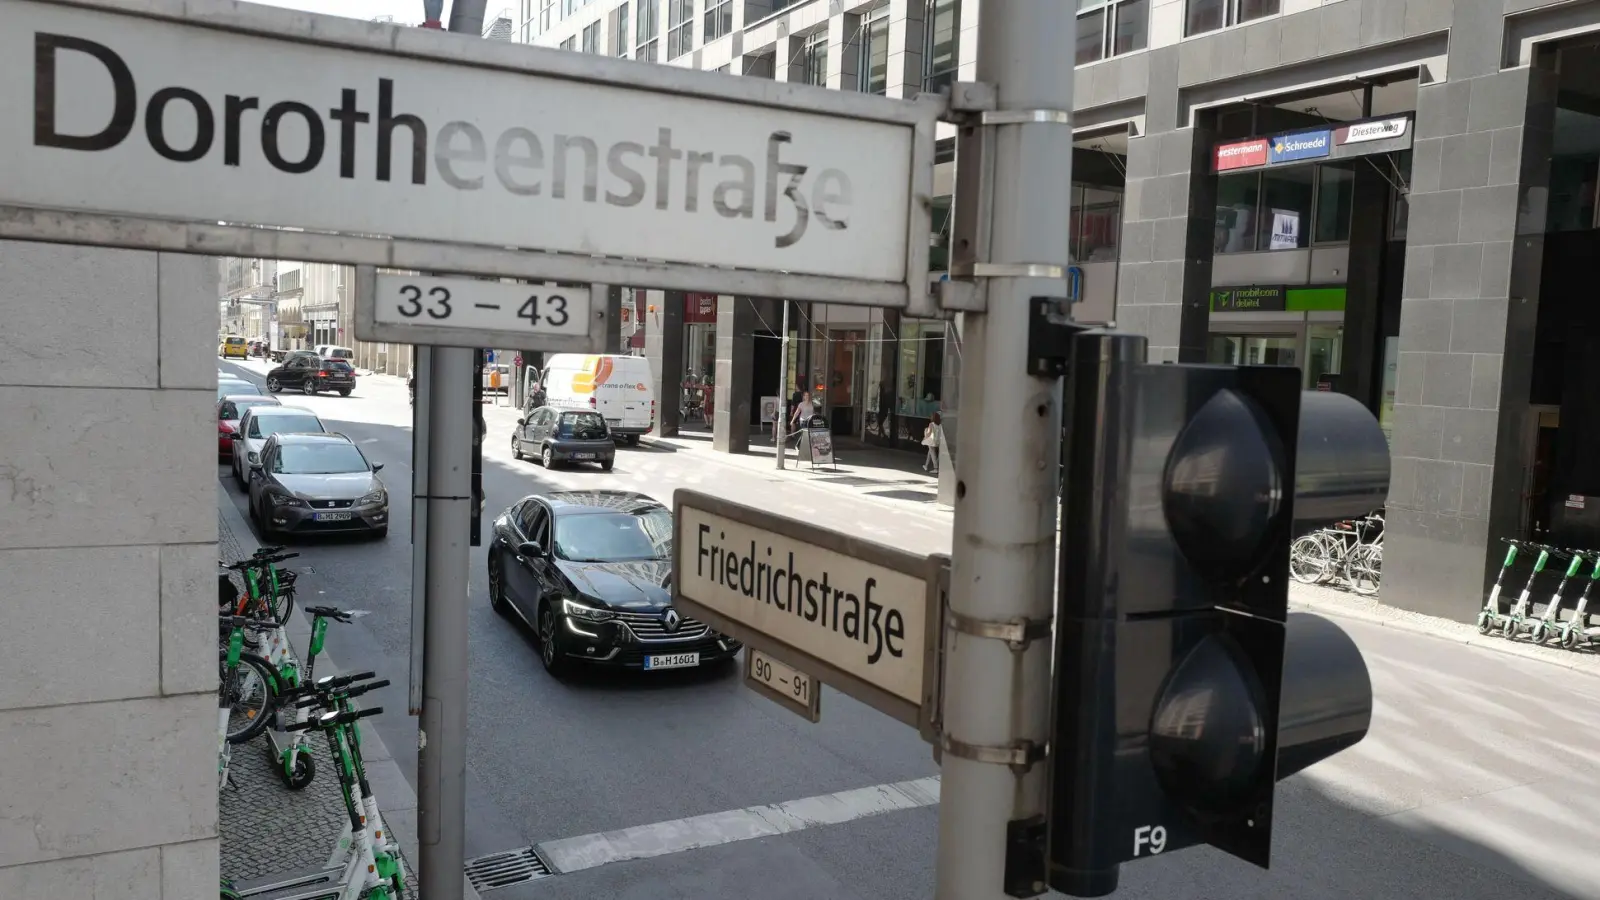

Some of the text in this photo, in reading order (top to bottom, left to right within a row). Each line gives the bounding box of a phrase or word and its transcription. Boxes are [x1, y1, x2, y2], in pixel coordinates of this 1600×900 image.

[34, 32, 853, 249] Dorotheenstraße
[1285, 136, 1326, 152] Schroedel
[1351, 122, 1399, 138] Diesterweg
[397, 285, 453, 319] 33
[517, 295, 570, 327] 43
[1236, 287, 1279, 298] mobilcom
[1236, 298, 1260, 308] debitel
[698, 523, 905, 665] Friedrichstraße
[755, 658, 772, 682] 90
[793, 676, 809, 700] 91
[1133, 825, 1167, 857] F9
